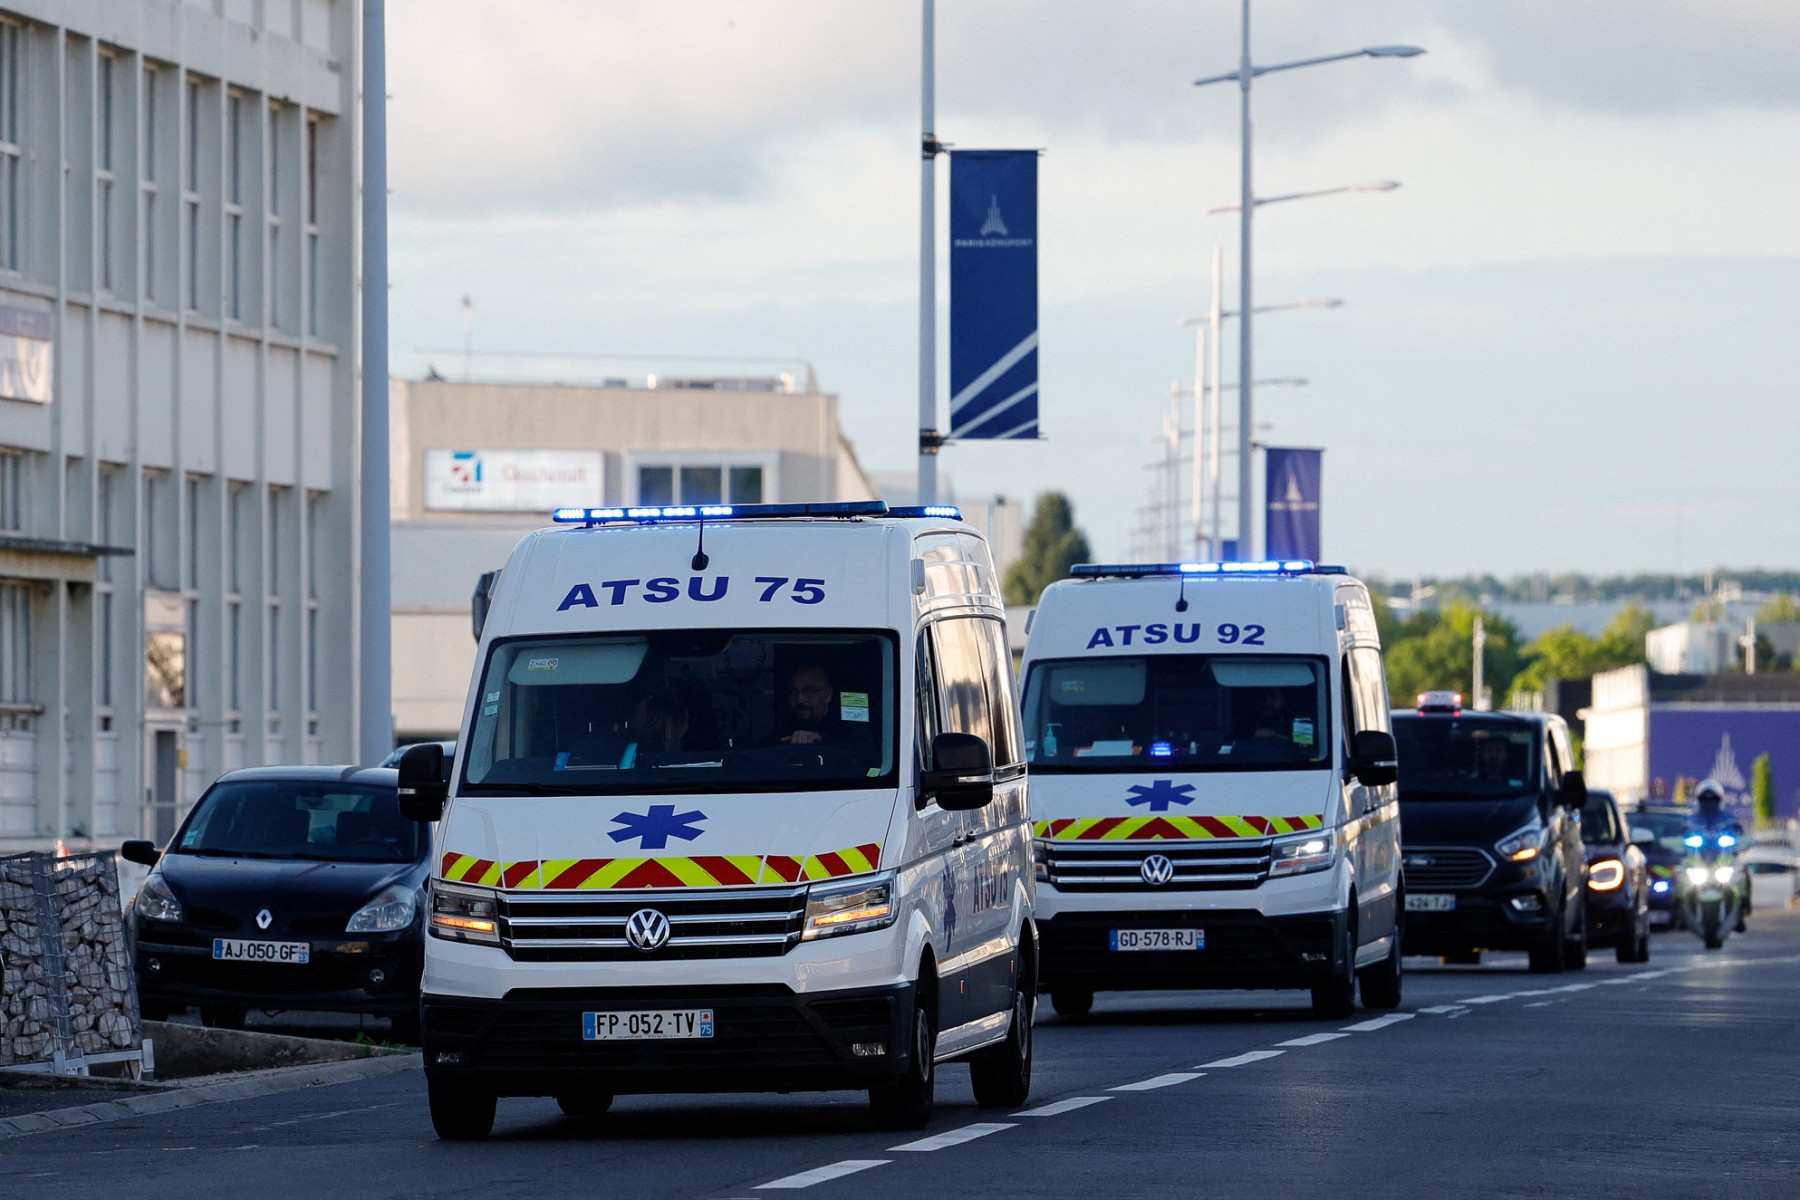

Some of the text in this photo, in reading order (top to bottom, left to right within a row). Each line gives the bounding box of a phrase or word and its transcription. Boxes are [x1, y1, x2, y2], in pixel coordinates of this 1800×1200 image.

[556, 576, 825, 611] ATSU 75
[1086, 623, 1265, 649] ATSU 92
[1120, 931, 1193, 947] GD-578-RJ
[224, 942, 299, 960] AJ-050-GF
[596, 1012, 695, 1035] FP-052-TV
[701, 1024, 712, 1035] 75
